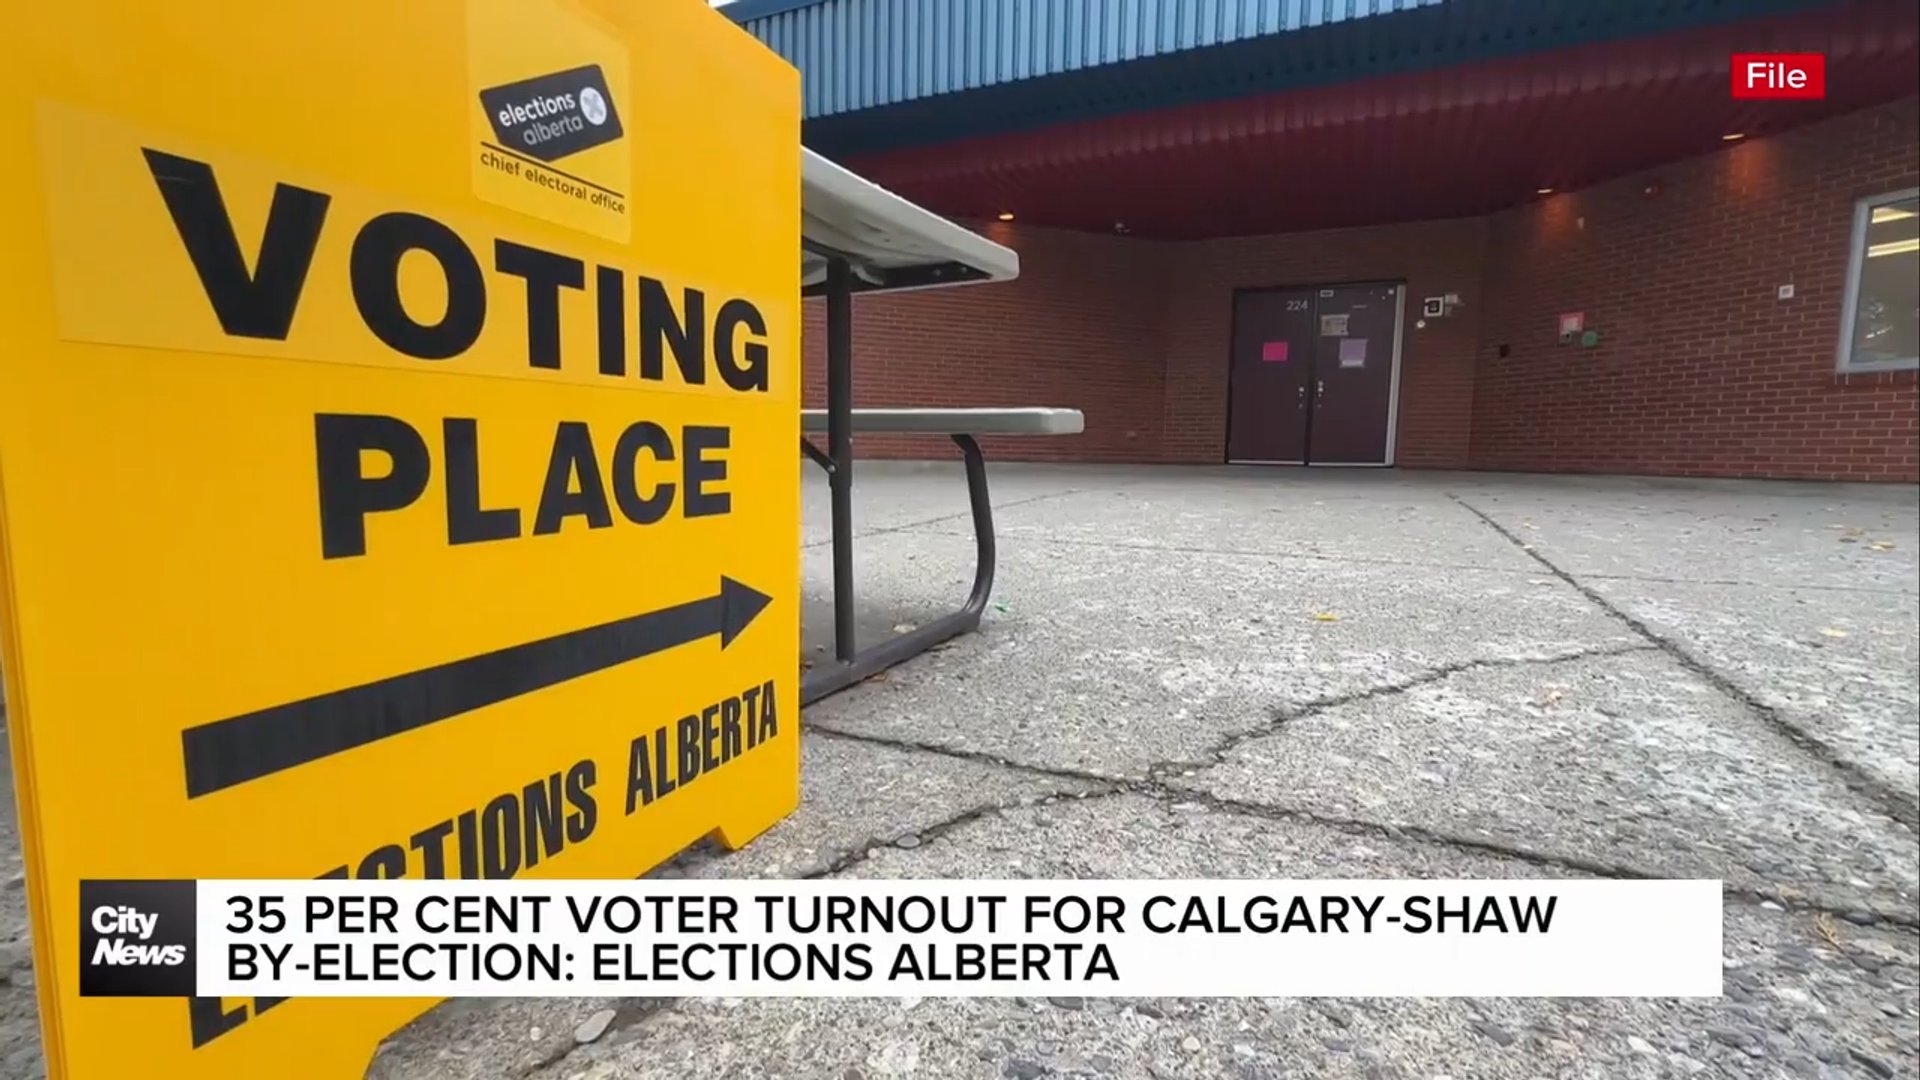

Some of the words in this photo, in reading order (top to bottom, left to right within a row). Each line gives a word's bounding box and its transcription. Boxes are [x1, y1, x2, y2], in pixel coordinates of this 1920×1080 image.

[498, 93, 576, 127] elections
[523, 115, 584, 146] alberta
[480, 152, 521, 176] chief
[524, 166, 587, 200] electoral
[590, 191, 625, 214] office
[141, 147, 768, 392] VOTING
[1286, 300, 1308, 311] 224
[314, 412, 731, 560] PLACE
[625, 680, 777, 816] ALBERTA
